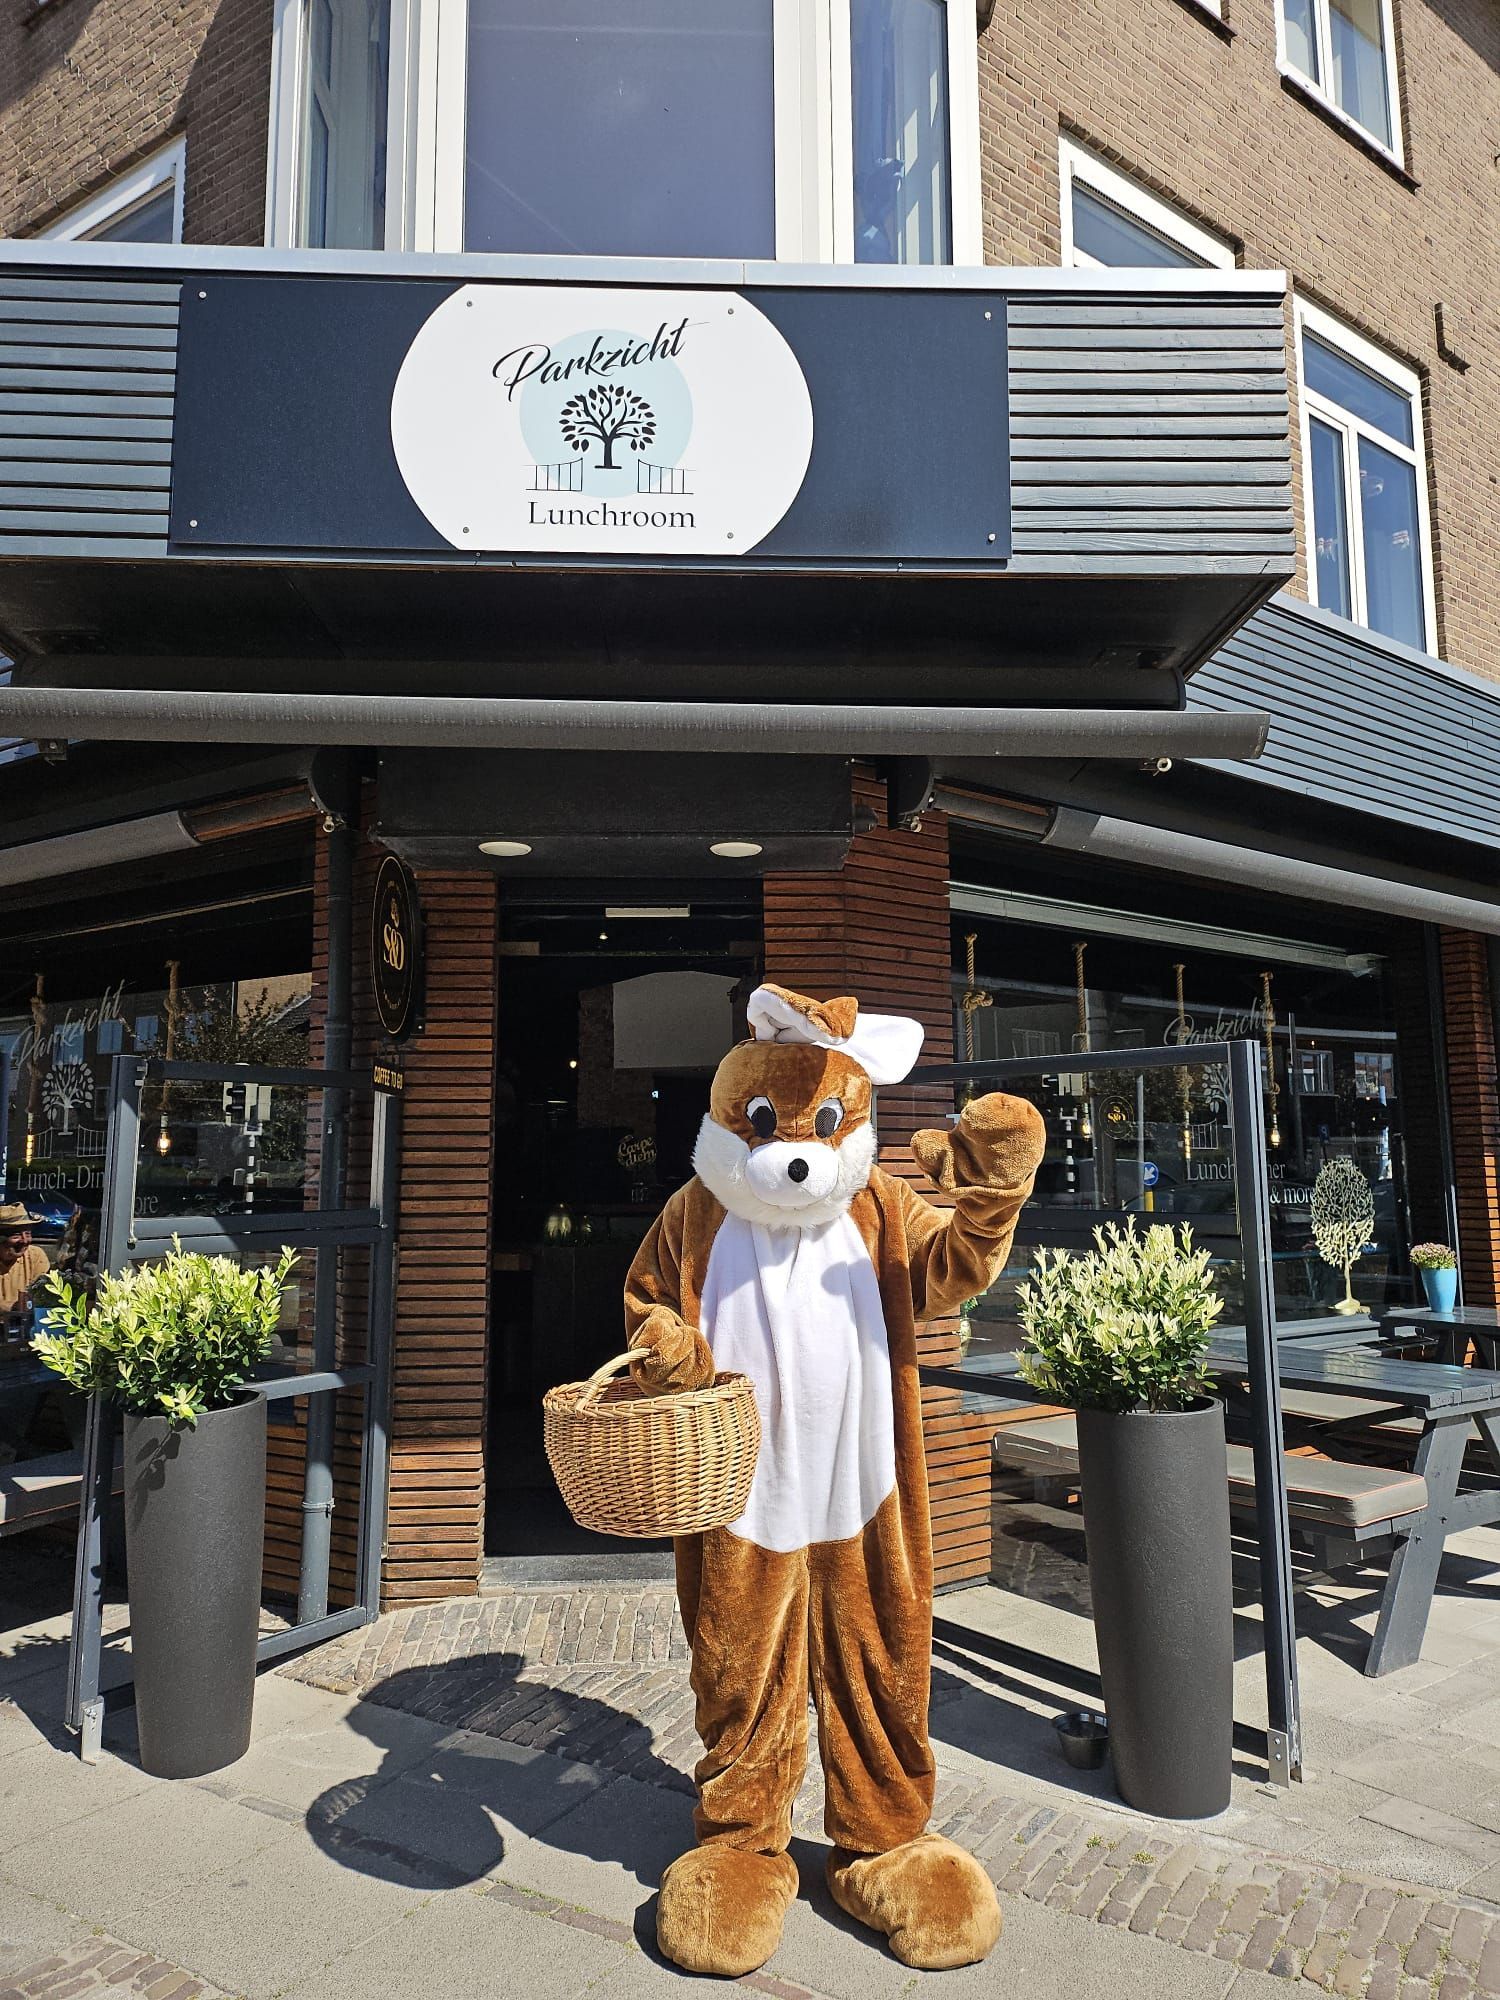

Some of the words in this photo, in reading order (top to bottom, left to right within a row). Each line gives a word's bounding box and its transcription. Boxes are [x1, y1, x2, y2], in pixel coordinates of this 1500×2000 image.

[492, 317, 711, 403] Parkzicht
[528, 501, 697, 529] Lunchroom
[9, 978, 136, 1074] Parkzicht
[373, 1065, 391, 1087] COFFEE
[16, 1164, 105, 1191] Lunch-Din
[134, 1194, 160, 1215] ore
[1269, 1184, 1281, 1204] &
